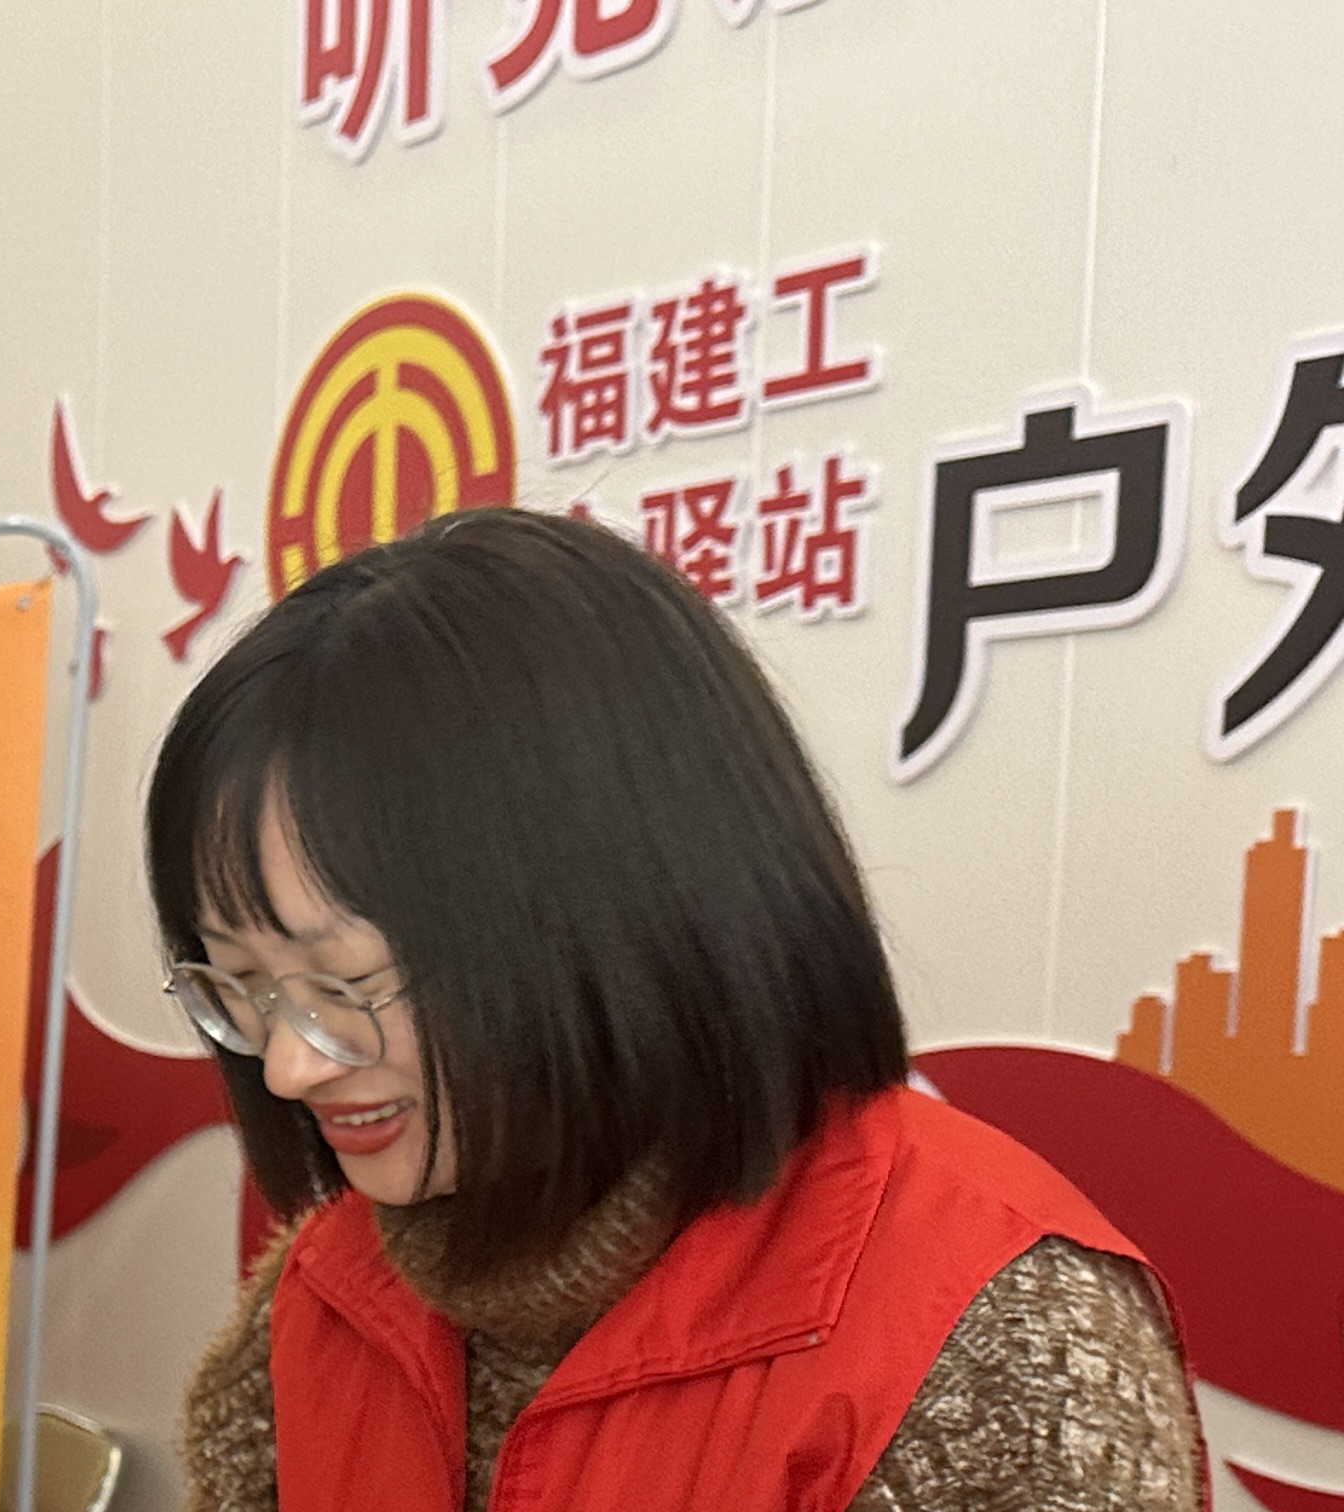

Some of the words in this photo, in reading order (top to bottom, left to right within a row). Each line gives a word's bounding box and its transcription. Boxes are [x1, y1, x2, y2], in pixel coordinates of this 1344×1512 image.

[539, 255, 869, 457] 福建工
[569, 455, 866, 611] 驿站
